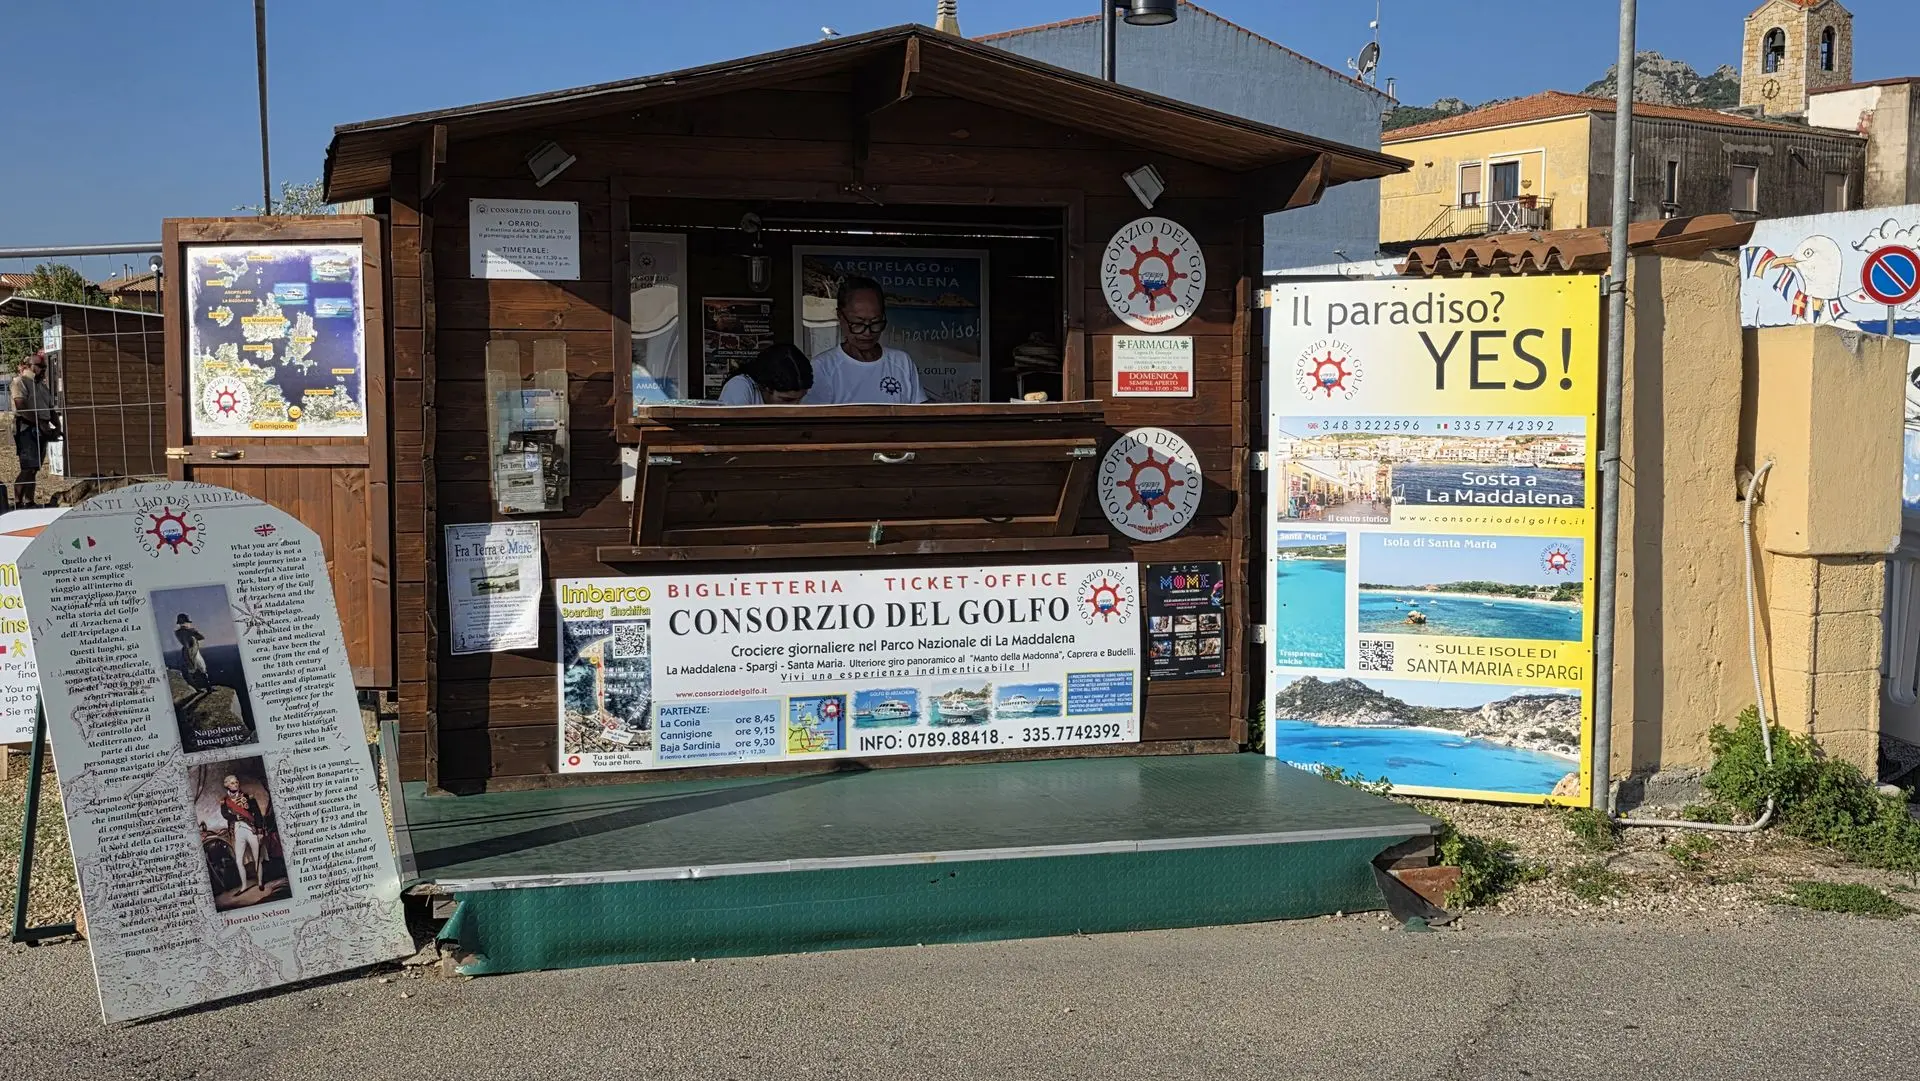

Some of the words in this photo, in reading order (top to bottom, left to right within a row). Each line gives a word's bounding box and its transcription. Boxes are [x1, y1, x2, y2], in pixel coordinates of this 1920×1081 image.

[1160, 222, 1189, 251] DEL
[833, 260, 941, 273] ARCIPELAGO
[1105, 221, 1154, 314] CONSORZIO
[1174, 255, 1202, 317] GOLFO
[1293, 295, 1312, 326] Il
[1328, 290, 1505, 334] paradiso?
[1127, 340, 1179, 349] FARMACIA
[1417, 327, 1572, 391] YES!
[1296, 339, 1327, 401] CONSORZIO
[1332, 339, 1352, 357] DEL
[1344, 359, 1364, 401] GOLFO
[254, 422, 294, 431] Cannigione
[1322, 420, 1348, 431] 348
[1355, 420, 1420, 431] 3222596
[1454, 420, 1480, 431] 335
[1487, 420, 1554, 431] 7742392
[1103, 432, 1148, 525] CONSORZIO
[1155, 432, 1184, 459] DEL
[1172, 462, 1199, 524] GOLFO
[1462, 472, 1520, 487] Sosta
[1524, 475, 1537, 486] a
[1426, 489, 1449, 503] La
[1456, 489, 1574, 505] Maddalena
[1336, 515, 1361, 523] centro
[1362, 514, 1389, 523] storico
[1399, 515, 1585, 526] www.consorziodelgolfo.it
[191, 513, 207, 556] GOLFO
[1304, 533, 1327, 541] Maria
[231, 543, 250, 551] What
[455, 544, 470, 557] Fra
[472, 543, 497, 556] Terra
[500, 545, 505, 555] e
[508, 540, 533, 554] Mare
[1384, 538, 1410, 547] Isola
[1413, 538, 1425, 547] di
[1428, 539, 1460, 548] Santa
[1464, 539, 1497, 549] Maria
[253, 549, 274, 558] today
[61, 556, 88, 566] Quello
[232, 560, 256, 569] simple
[257, 558, 284, 567] journey
[42, 566, 85, 577] apprestate
[91, 572, 125, 581] semplice
[238, 566, 275, 577] wonderful
[276, 564, 305, 573] Natural
[51, 585, 80, 594] viaggio
[250, 584, 275, 593] history
[562, 584, 651, 604] Imbarco
[668, 579, 843, 598] BIGLIETTERIA
[884, 572, 1067, 591] TICKET-OFFICE
[1076, 569, 1104, 626] CONSORZIO
[1107, 568, 1126, 585] DEL
[1118, 586, 1135, 625] GOLFO
[264, 598, 305, 609] Maddalena
[78, 610, 102, 618] storia
[293, 613, 321, 623] already
[562, 606, 604, 619] Boarding
[609, 605, 651, 617] Einschiffen
[669, 603, 875, 636] CONSORZIO
[885, 600, 950, 628] DEL
[958, 596, 1070, 626] GOLFO
[80, 617, 122, 628] Arzachena
[294, 630, 326, 640] medieval
[573, 627, 591, 635] Scan
[592, 626, 609, 635] here
[731, 644, 784, 657] Crociere
[788, 641, 855, 658] giornaliere
[859, 640, 877, 652] nel
[881, 639, 914, 651] Parco
[918, 635, 977, 650] Nazionale
[980, 635, 992, 647] di
[996, 635, 1008, 646] La
[1011, 632, 1075, 646] Maddalena
[70, 647, 95, 657] Questi
[1435, 644, 1486, 656] SULLE
[1489, 646, 1537, 658] ISOLE
[1540, 648, 1557, 659] DI
[5, 663, 22, 671] Per
[295, 657, 322, 667] century
[666, 665, 678, 675] La
[680, 663, 736, 675] Maddalena
[746, 660, 778, 674] Spargi
[787, 660, 814, 670] Santa
[816, 658, 846, 669] Maria.
[849, 657, 886, 668] Ulteriore
[888, 657, 905, 668] giro
[907, 654, 956, 667] panoramico
[958, 654, 966, 663] al
[1001, 652, 1020, 661] della
[1067, 649, 1098, 660] Caprera
[1107, 647, 1136, 657] Budelli.
[18, 669, 37, 679] fino
[781, 672, 804, 681] Vivi
[811, 672, 833, 681] una
[840, 668, 910, 680] esperienza
[916, 664, 1015, 676] indimenticabile
[1407, 658, 1458, 674] SANTA
[1461, 661, 1513, 677] MARIA
[1517, 669, 1522, 677] E
[1526, 663, 1583, 680] SPARGI
[298, 672, 337, 684] diplomatic
[5, 685, 23, 694] You
[676, 687, 768, 699] www.consorziodelgolfo.it
[6, 694, 19, 704] up
[6, 707, 21, 717] Sie
[660, 705, 710, 717] PARTENZE:
[660, 720, 671, 729] La
[673, 718, 701, 728] Conia
[735, 716, 752, 725] ore
[754, 714, 776, 726] 8,45
[96, 728, 132, 738] controllo
[194, 725, 242, 738] Napoleone
[660, 730, 713, 741] Cannigione
[735, 728, 752, 737] ore
[754, 727, 776, 737] 9,15
[197, 734, 244, 746] Bonaparte
[660, 743, 681, 754] Baja
[683, 740, 721, 751] Sardinia
[735, 740, 752, 749] ore
[754, 738, 776, 749] 9,30
[860, 734, 902, 751] INFO:
[83, 755, 128, 770] personaggi
[338, 818, 368, 830] Admiral
[261, 907, 290, 919] Nelson
